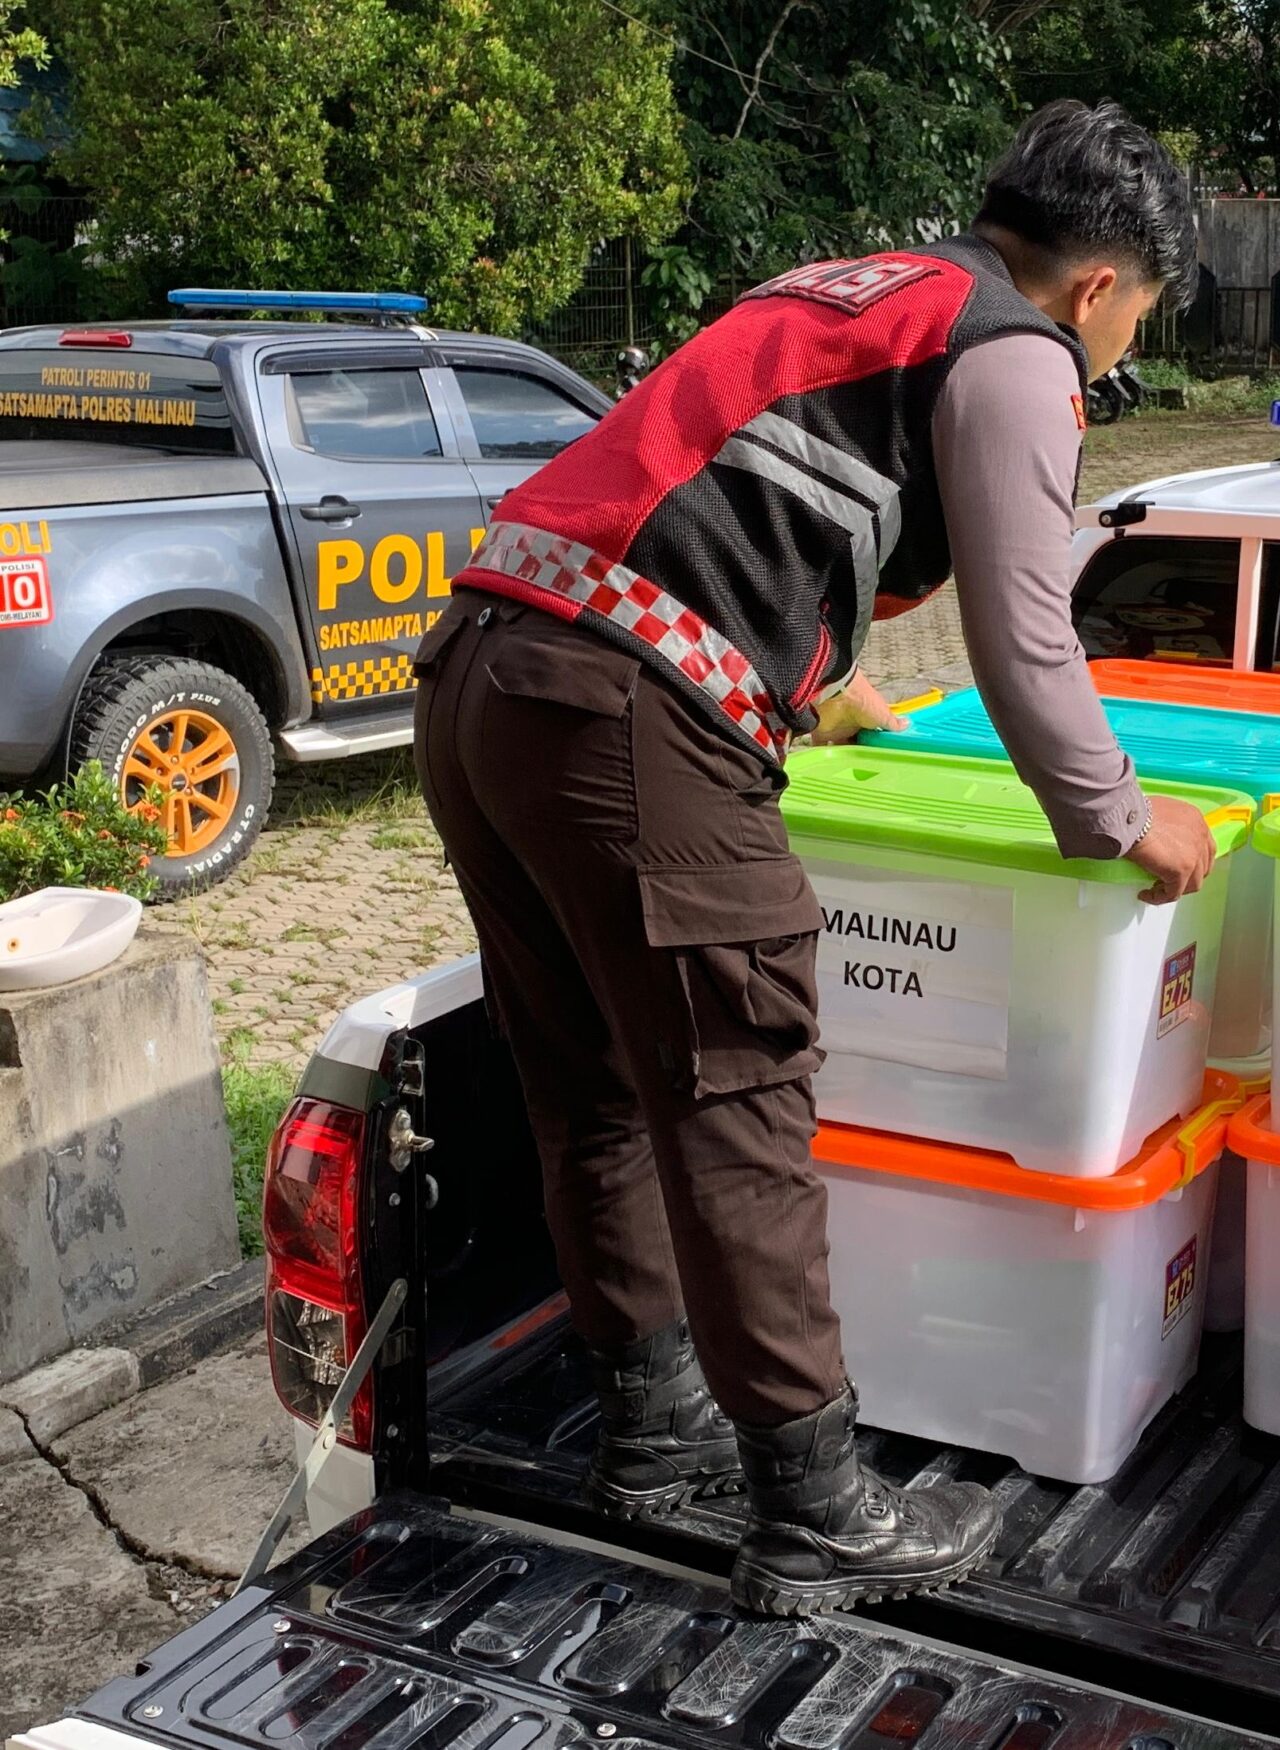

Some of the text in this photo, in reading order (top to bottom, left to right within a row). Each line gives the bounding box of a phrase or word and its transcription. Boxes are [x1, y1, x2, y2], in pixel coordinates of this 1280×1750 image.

[41, 367, 150, 391] PATROLI PERINTIS 01
[81, 396, 131, 423] POLRES
[135, 399, 196, 427] MALINAU
[1, 562, 36, 571] POLISI
[320, 613, 423, 651] SATSAMAPTA
[112, 692, 221, 801] OMODO M/T PLUS
[820, 906, 957, 952] MALINAU
[843, 960, 924, 998] KOTA
